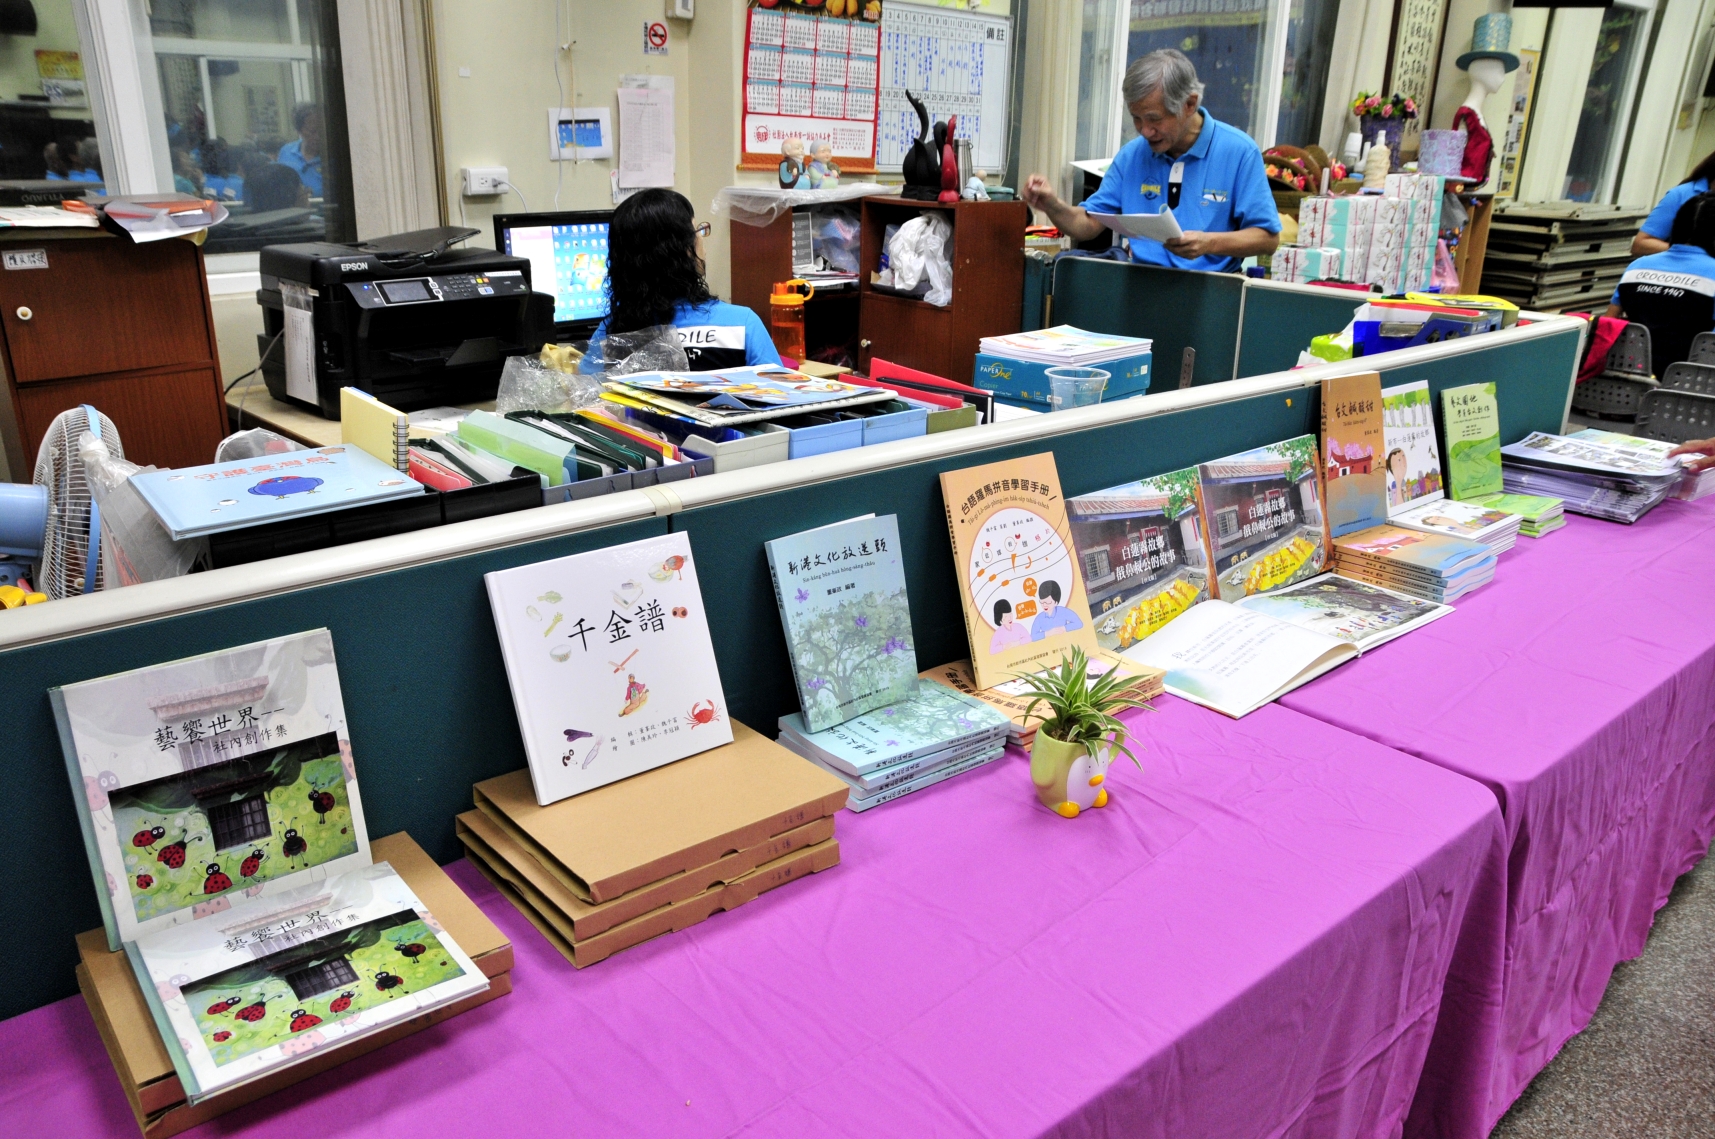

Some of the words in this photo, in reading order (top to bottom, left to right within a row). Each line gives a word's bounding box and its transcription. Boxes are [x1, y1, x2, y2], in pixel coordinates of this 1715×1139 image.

[986, 27, 1005, 41] 備註
[931, 93, 937, 101] 25
[961, 95, 966, 103] 29
[976, 96, 981, 104] 31
[340, 262, 368, 272] EPSON
[1635, 271, 1701, 287] CROCODILE
[1636, 284, 1663, 294] SINCE
[1663, 287, 1685, 298] 1947
[979, 380, 999, 389] Copier
[961, 478, 1050, 516] 台語羅馬拼音學習手冊
[1248, 497, 1286, 519] 白蓮霧故鄉
[787, 538, 888, 576] 新港文化放送頭
[1121, 535, 1164, 560] 白蓮霧故鄉
[567, 598, 667, 652] 千金譜
[213, 724, 289, 754] 社內創作集
[284, 914, 361, 943] 社內創作集
